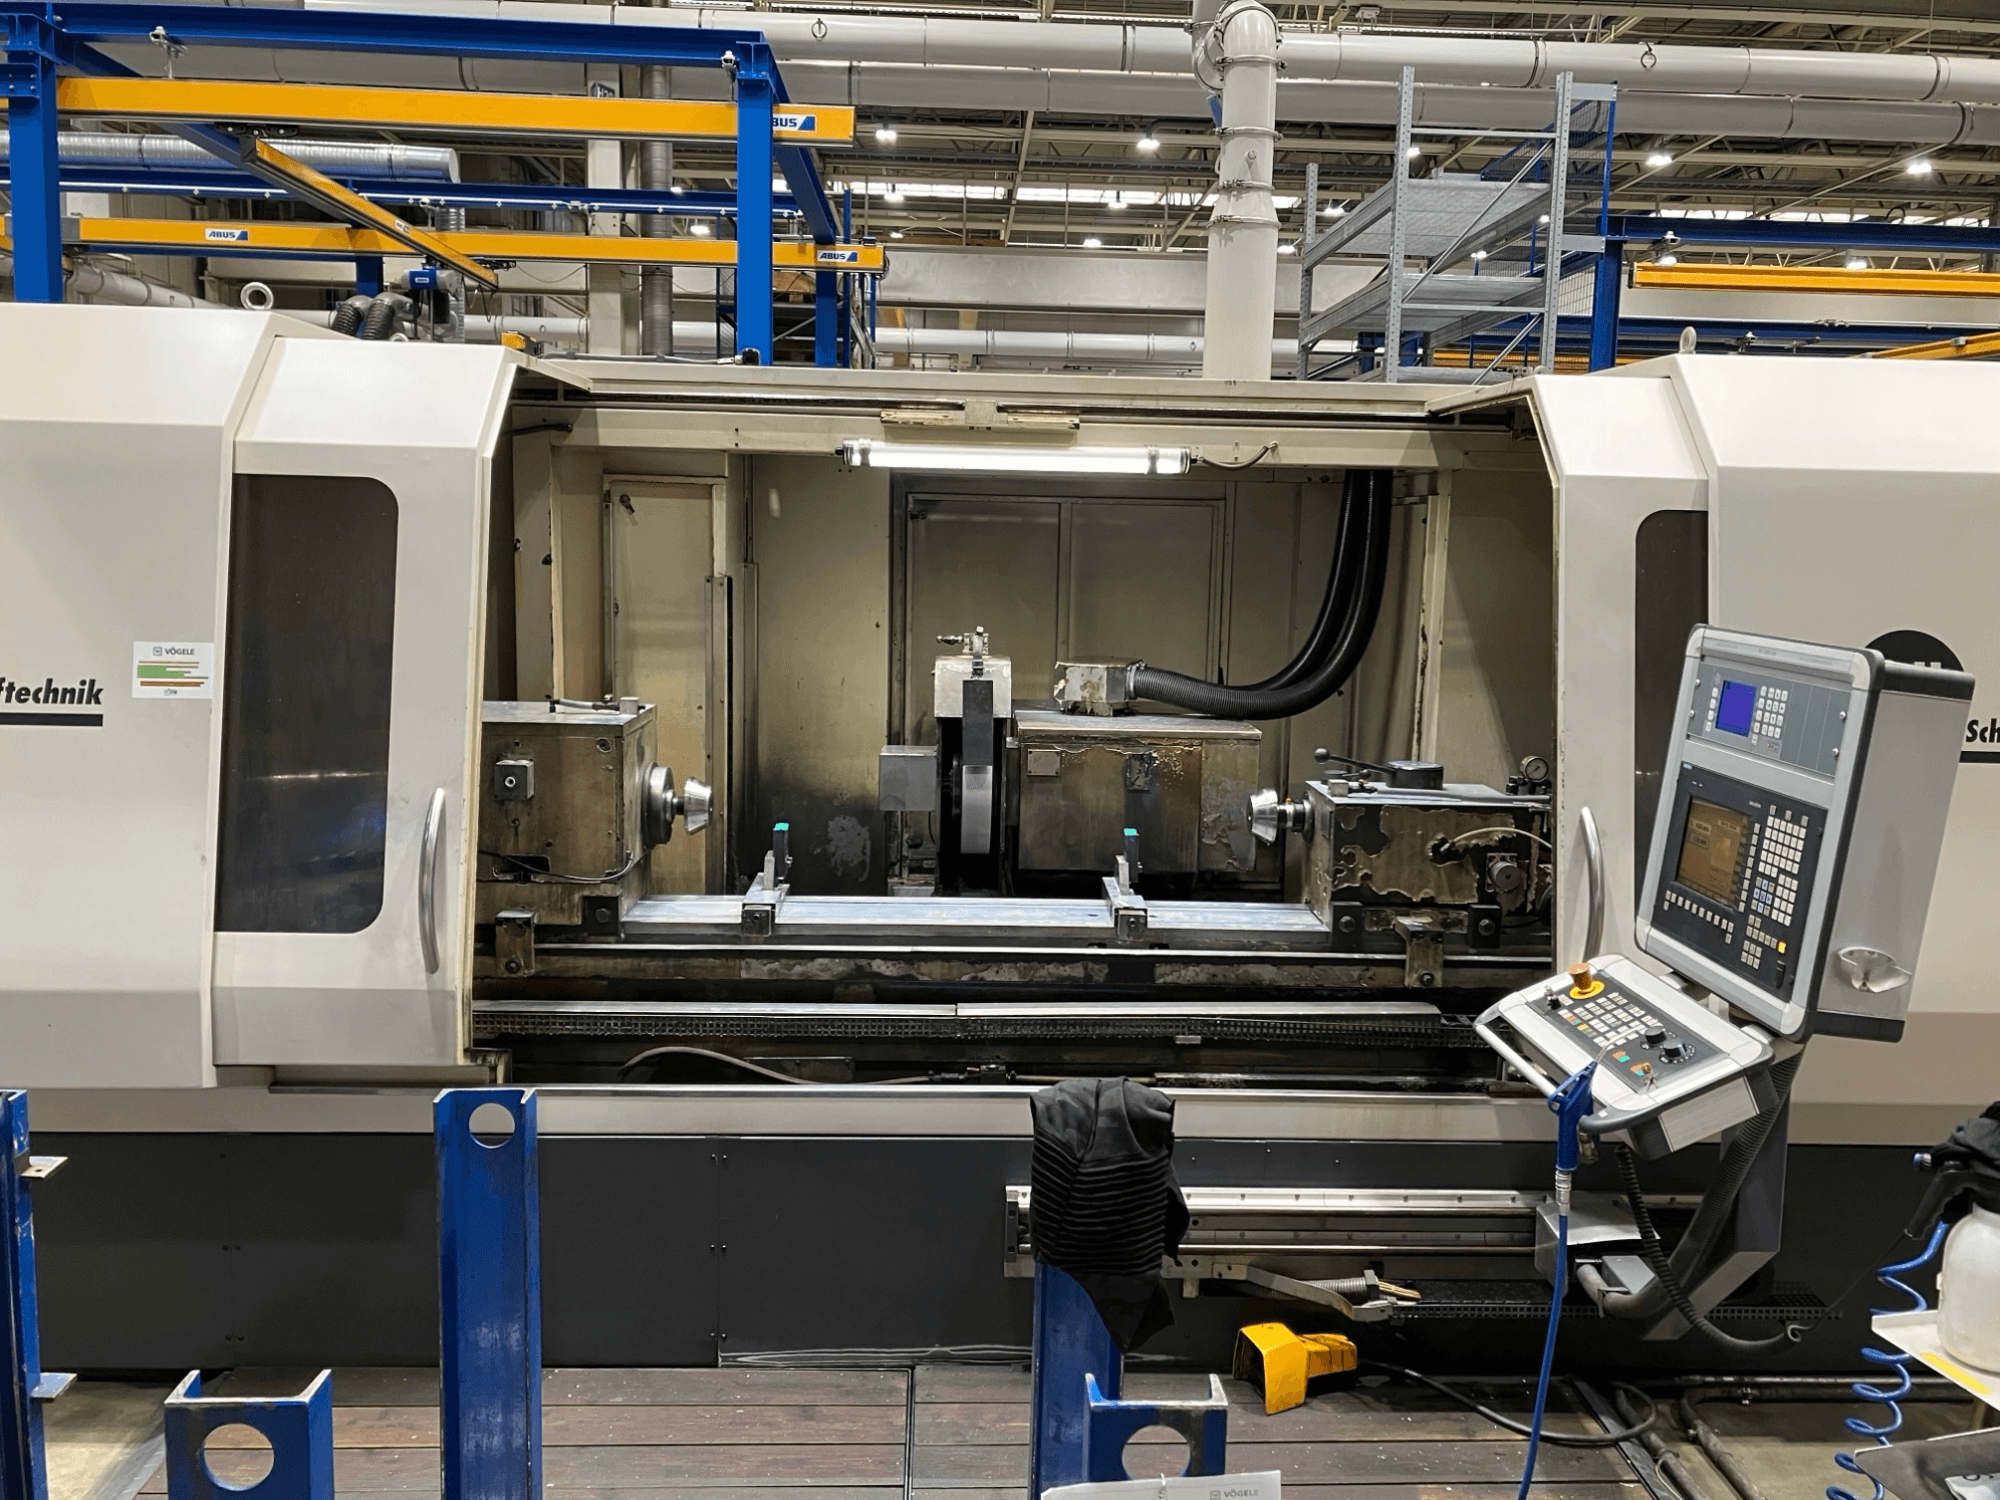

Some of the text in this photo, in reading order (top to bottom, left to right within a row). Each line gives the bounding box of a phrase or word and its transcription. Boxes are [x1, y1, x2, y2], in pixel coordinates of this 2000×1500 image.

[772, 117, 798, 128] BUS
[208, 230, 236, 238] ABUS
[820, 252, 846, 260] ABUS
[165, 646, 195, 656] VÖGELE
[1965, 717, 2000, 743] Sch
[1223, 1488, 1259, 1498] VÖGELE
